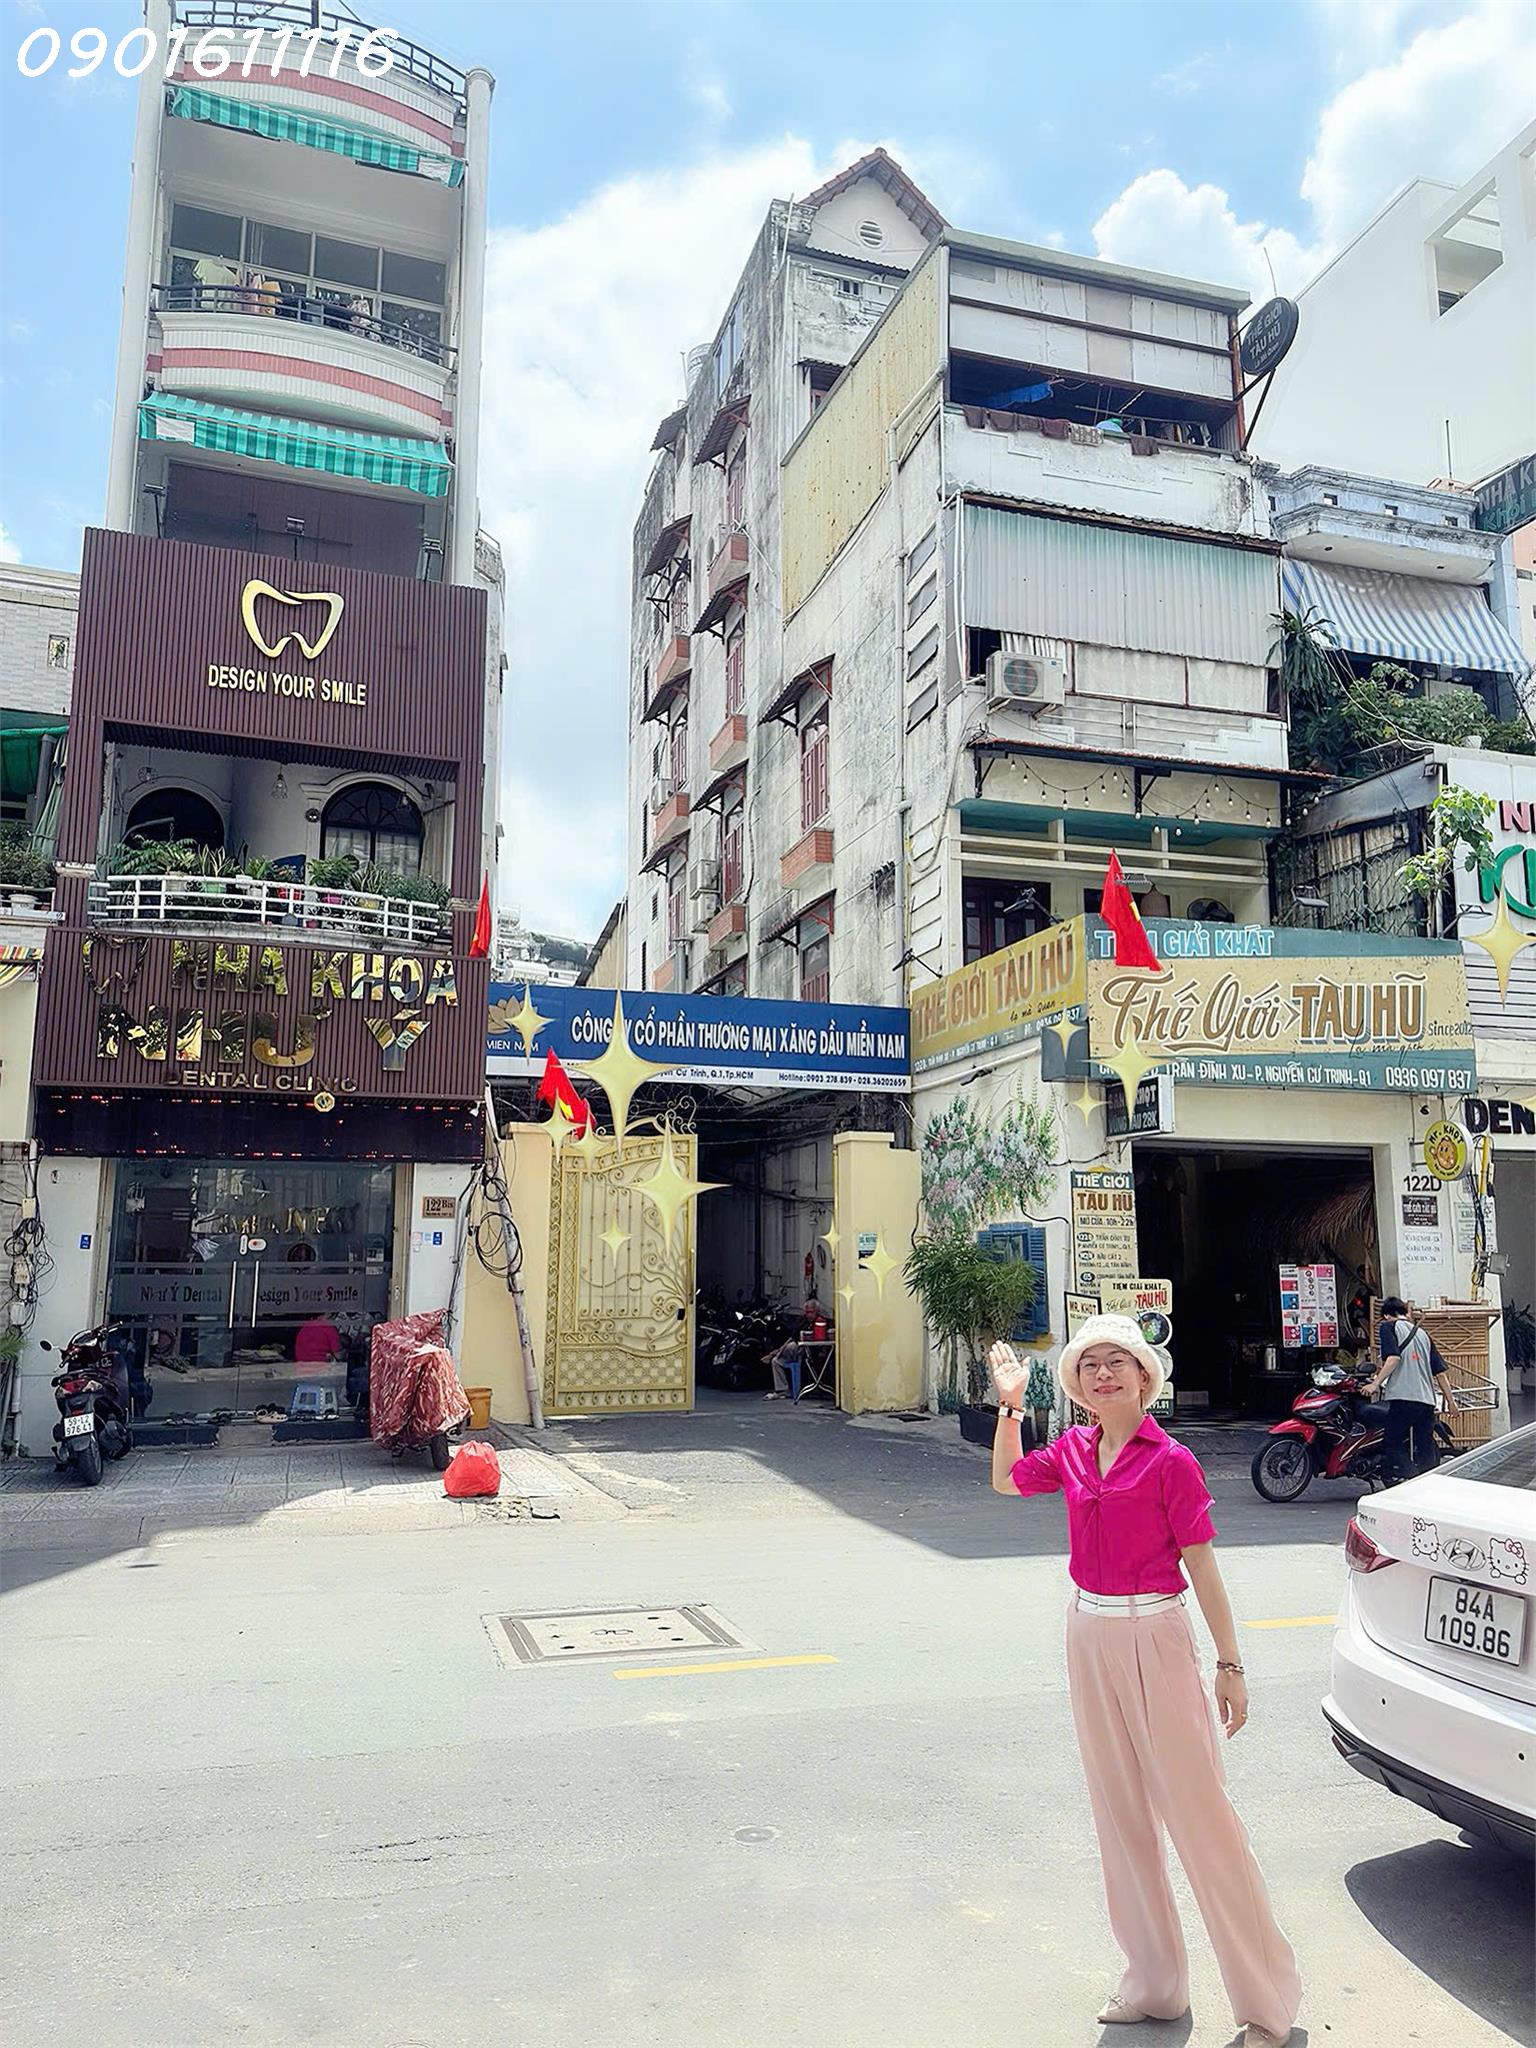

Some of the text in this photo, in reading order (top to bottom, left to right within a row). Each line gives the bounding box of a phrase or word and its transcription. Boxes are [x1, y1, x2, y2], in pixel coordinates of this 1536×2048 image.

[208, 664, 366, 705] DESIGN YOUR SMILE
[1215, 924, 1275, 957] KHÁT
[172, 941, 458, 1007] NHA KHOA
[951, 963, 988, 1027] GIỚI
[993, 946, 1034, 1012] TÀU
[1037, 923, 1074, 996] HŨ
[1102, 971, 1427, 1053] Thế Giới TÀU HŨ
[97, 1003, 431, 1072] NHƯ Ý
[572, 1009, 613, 1044] CÔNG
[635, 1005, 657, 1047] CỔ
[659, 1009, 695, 1048] PHẦN
[699, 1020, 750, 1051] THƯƠNG
[752, 1026, 777, 1058] MẠI
[780, 1022, 816, 1055] XĂNG
[820, 1018, 844, 1056] DẦU
[847, 1019, 875, 1057] MIỀN
[877, 1034, 905, 1059] NAM
[167, 1069, 357, 1093] DENTAL CLINIC
[1266, 1061, 1304, 1084] NGUYỄN
[1385, 1066, 1418, 1087] 0936
[1422, 1068, 1446, 1089] 097
[1448, 1070, 1473, 1090] 837
[1075, 1173, 1130, 1189] THẾ GIỚI
[1403, 1175, 1442, 1192] 122D
[258, 1287, 290, 1306] esign
[326, 1285, 358, 1303] Smile
[1455, 1588, 1494, 1622] 84A
[1440, 1614, 1511, 1658] 109.86
